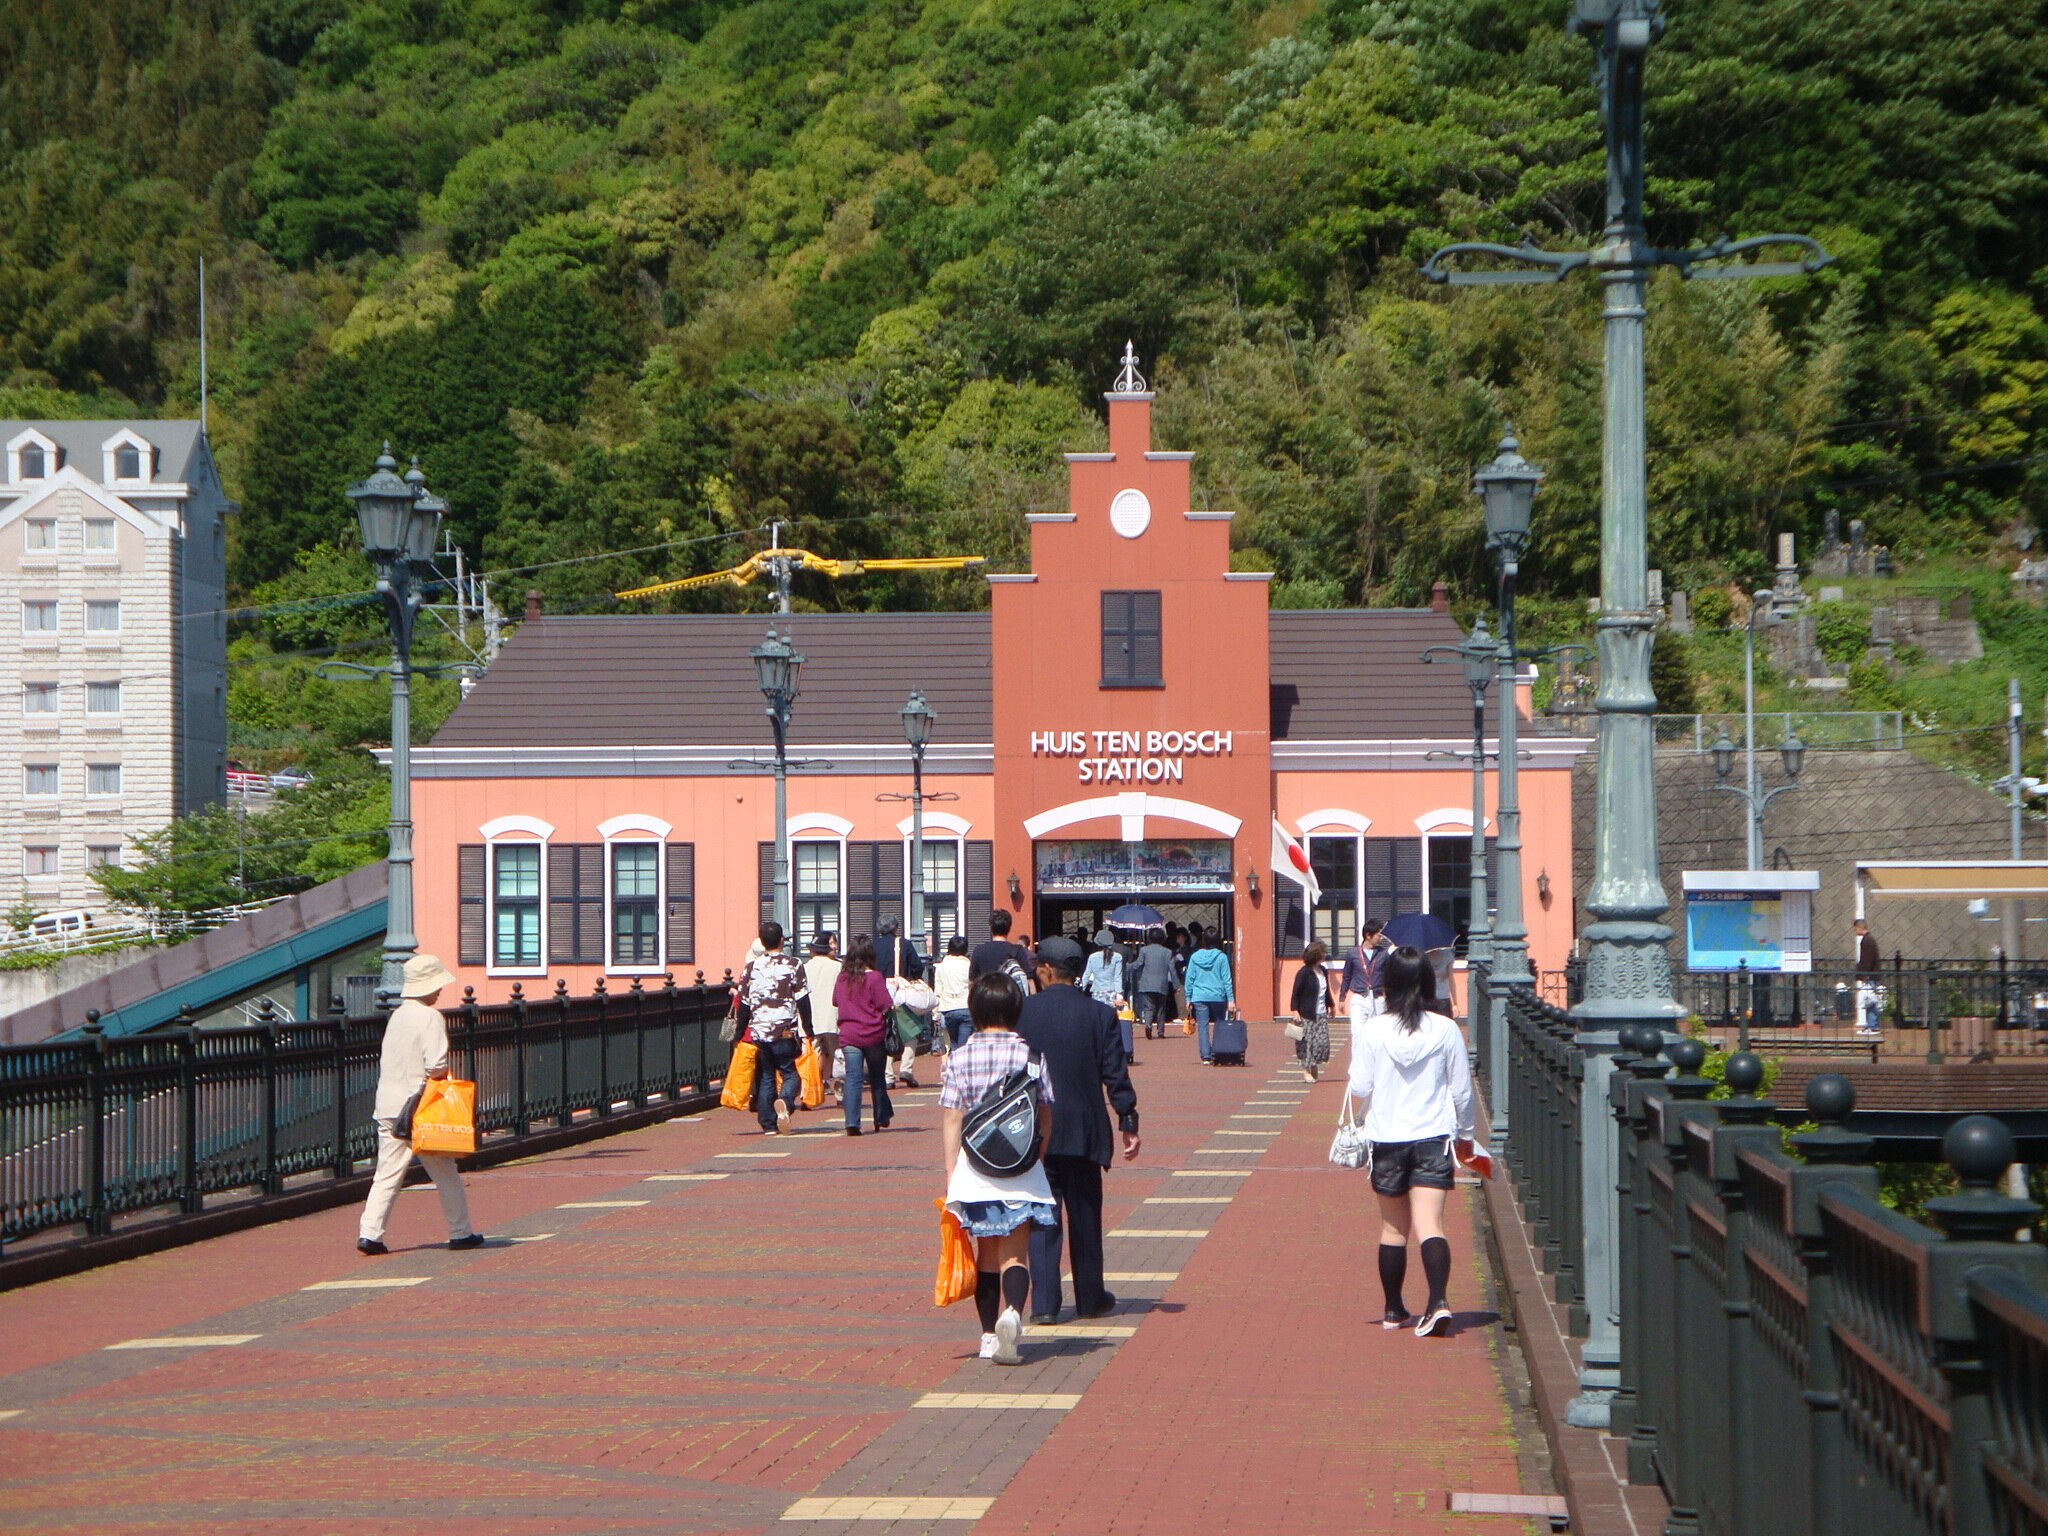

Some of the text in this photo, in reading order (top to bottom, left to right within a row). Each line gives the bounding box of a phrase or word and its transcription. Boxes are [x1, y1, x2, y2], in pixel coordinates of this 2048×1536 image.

[1031, 730, 1232, 753] HUIS TEN BOSCH
[1078, 757, 1183, 780] STATION
[1053, 875, 1220, 888] またのお越しをお待ちしております
